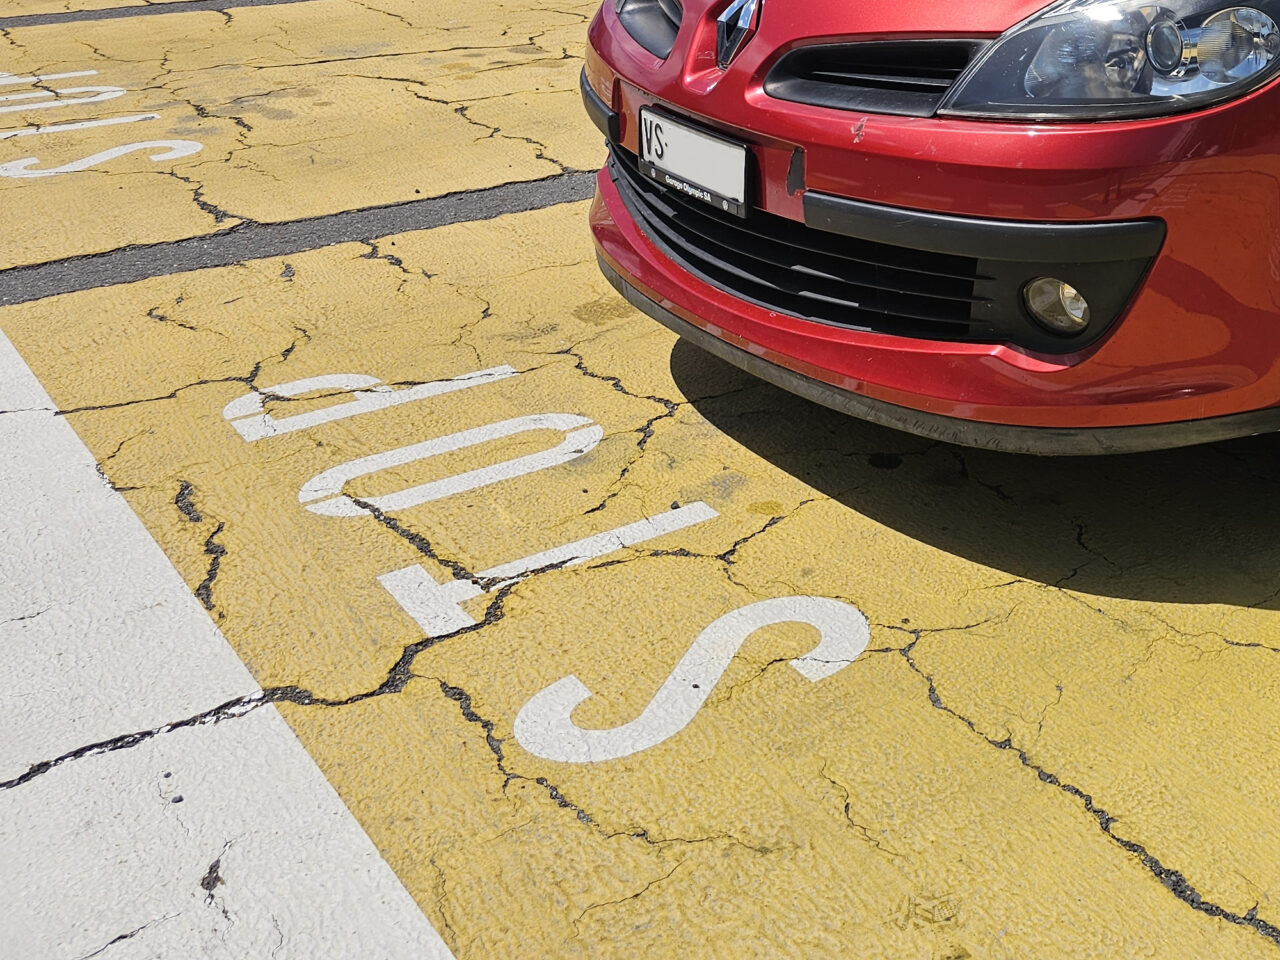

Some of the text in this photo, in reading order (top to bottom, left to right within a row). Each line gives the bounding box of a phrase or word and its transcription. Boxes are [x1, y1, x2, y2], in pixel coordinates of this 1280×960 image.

[665, 174, 712, 203] Garage Olympic SA
[222, 364, 872, 764] STOP
